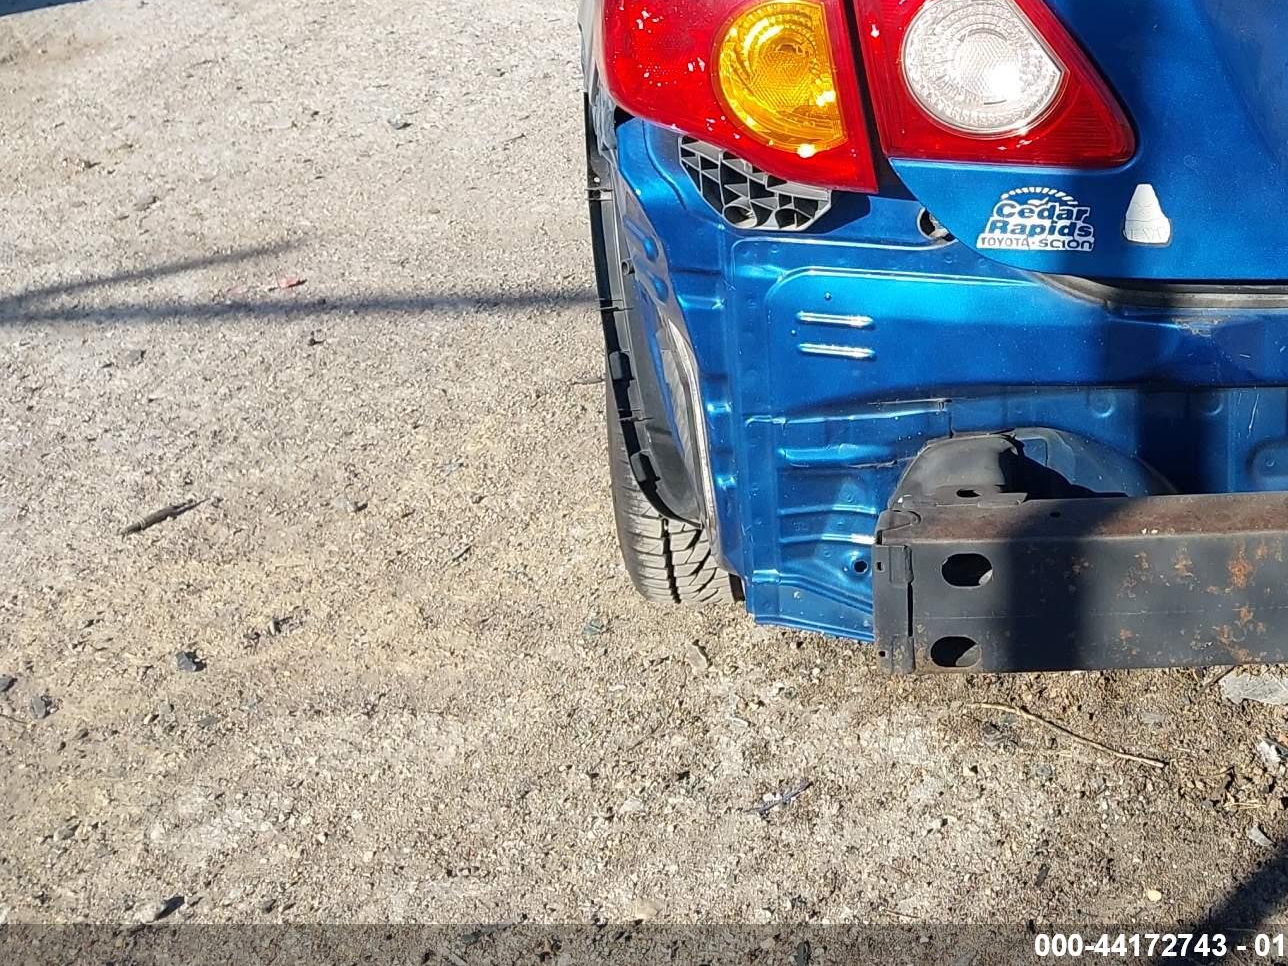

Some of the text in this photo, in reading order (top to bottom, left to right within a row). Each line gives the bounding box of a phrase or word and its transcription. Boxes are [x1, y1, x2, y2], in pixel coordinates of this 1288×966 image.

[993, 200, 1091, 222] Cedar
[987, 220, 1094, 238] Rapids
[981, 237, 1030, 247] TOYOTA
